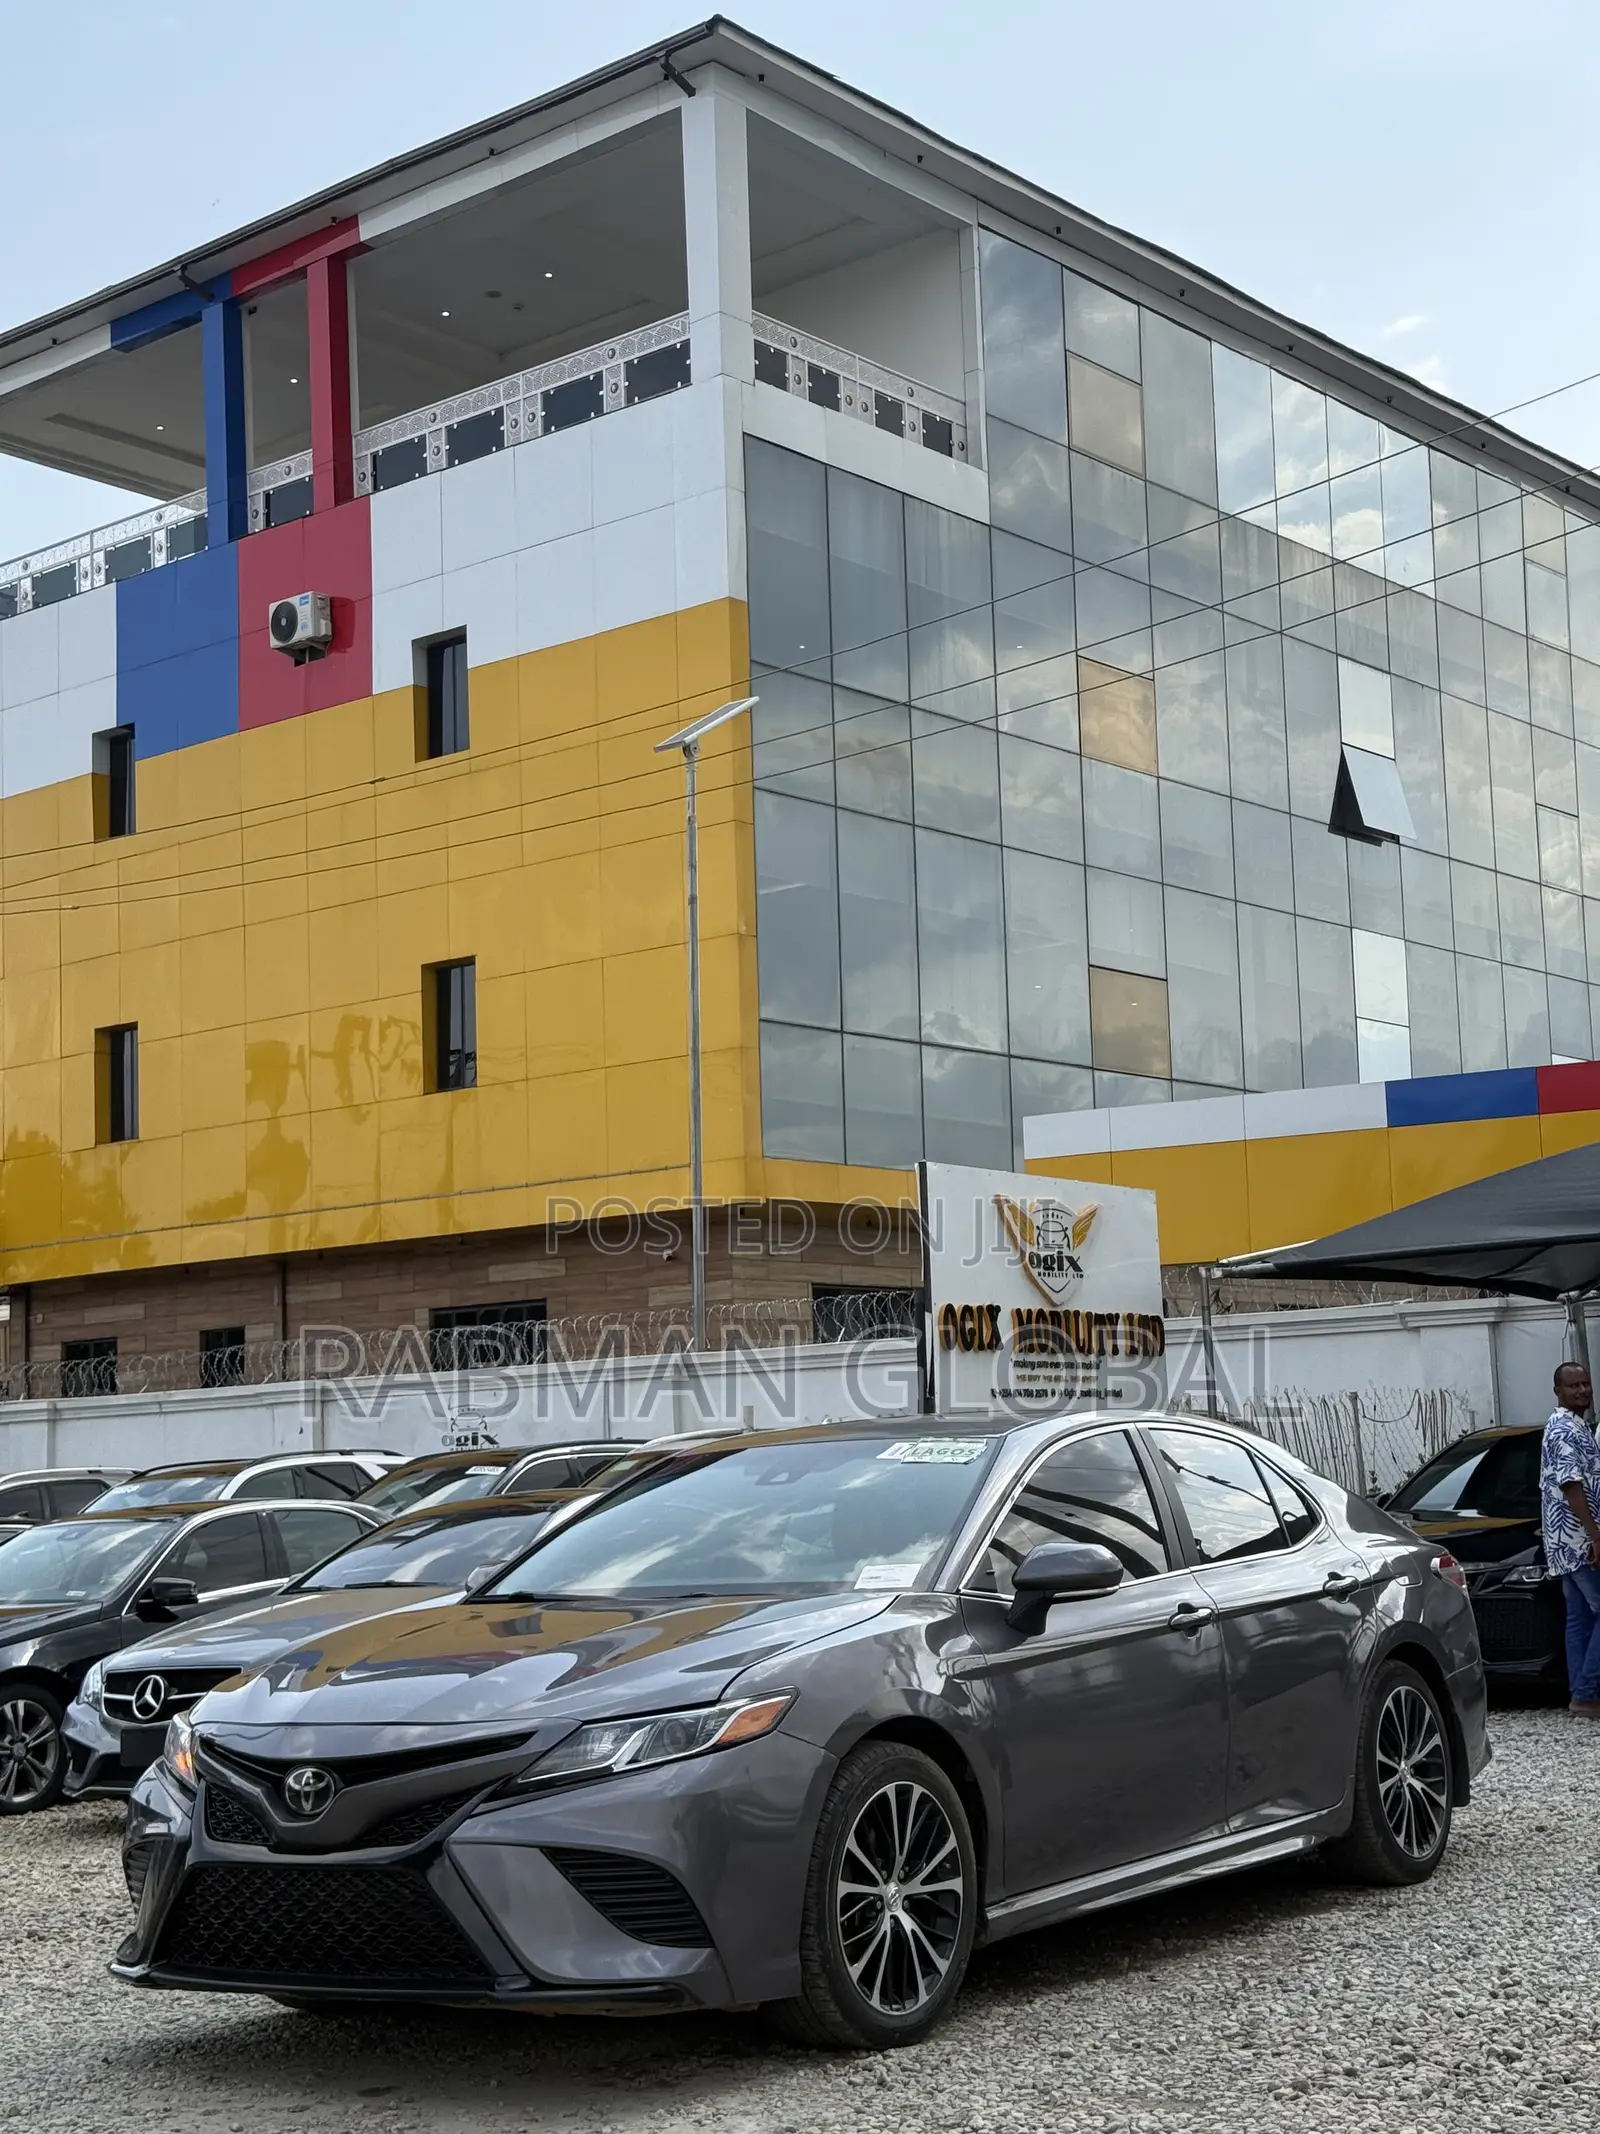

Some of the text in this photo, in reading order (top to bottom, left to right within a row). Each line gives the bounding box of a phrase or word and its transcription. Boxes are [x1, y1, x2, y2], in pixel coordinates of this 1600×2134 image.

[1037, 1271, 1069, 1279] MOBILITY
[938, 1303, 1004, 1353] OGIX
[1011, 1307, 1120, 1357] MOBILITY
[911, 1447, 977, 1457] LAGOS
